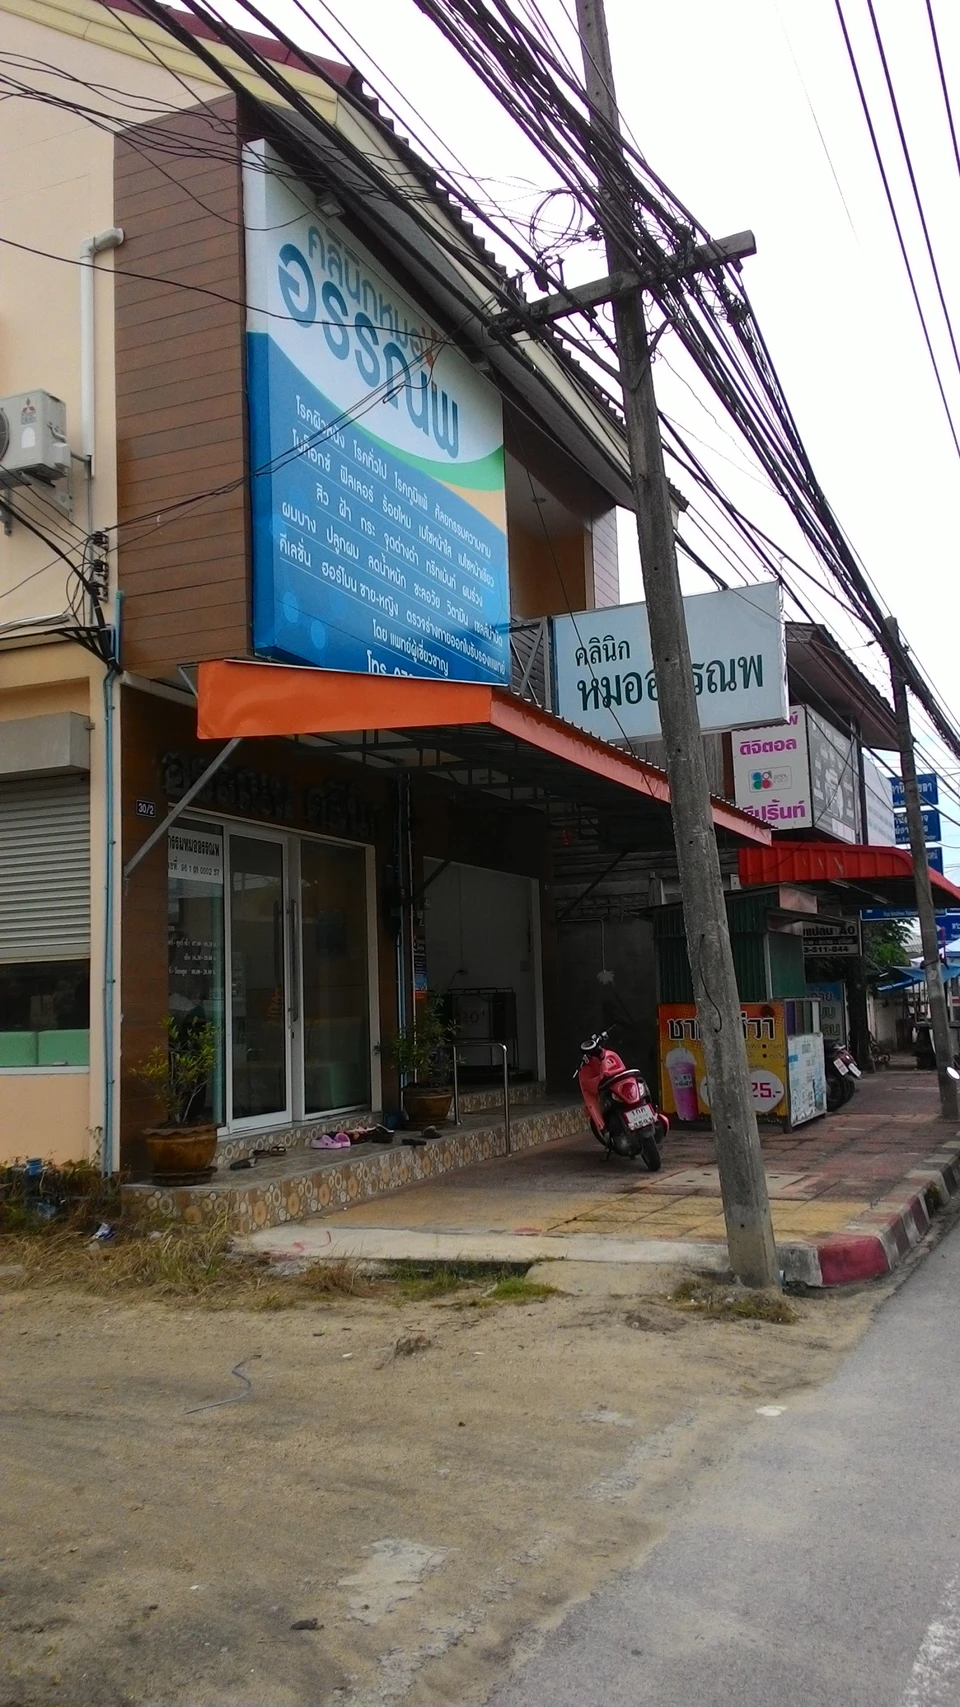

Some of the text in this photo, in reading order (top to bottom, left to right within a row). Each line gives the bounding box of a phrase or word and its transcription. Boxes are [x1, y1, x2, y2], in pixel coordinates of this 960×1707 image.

[278, 243, 459, 459] อรรณพ
[295, 394, 491, 559] โรคผิวหนัง โรคทั่วไป โรคภูมิแพ้ ศัลยกรรมความงาม
[282, 502, 317, 533] ผมบาง
[326, 525, 359, 560] ปลูกผม
[368, 552, 407, 589] ลดน้ำหนัก
[414, 583, 440, 609] ชะลอวัย
[447, 600, 469, 627] วิตามิน
[316, 482, 329, 506] สิว
[339, 497, 352, 521] ฝ้า
[360, 517, 376, 537] กระ
[383, 533, 419, 566] จุดด่างดำ
[462, 585, 483, 608] ผมร่วง
[382, 494, 411, 529] ร้อยไหม
[419, 524, 452, 559] เมโซหน้าใส
[458, 553, 495, 588] เมโซหน้าเรียว
[279, 533, 506, 676] คีเลชั่น ฮอร์โมน ชาย-หญิง ตรวจร่างกายออกใบรับรองแพทย์
[373, 618, 449, 677] โดย แพทย์ผู้เชี่ยวชาญ
[575, 634, 631, 667] คลินิก
[577, 654, 763, 711] หมออรณพ
[739, 738, 797, 756] ดิจิตอล
[138, 803, 154, 816] 30/2
